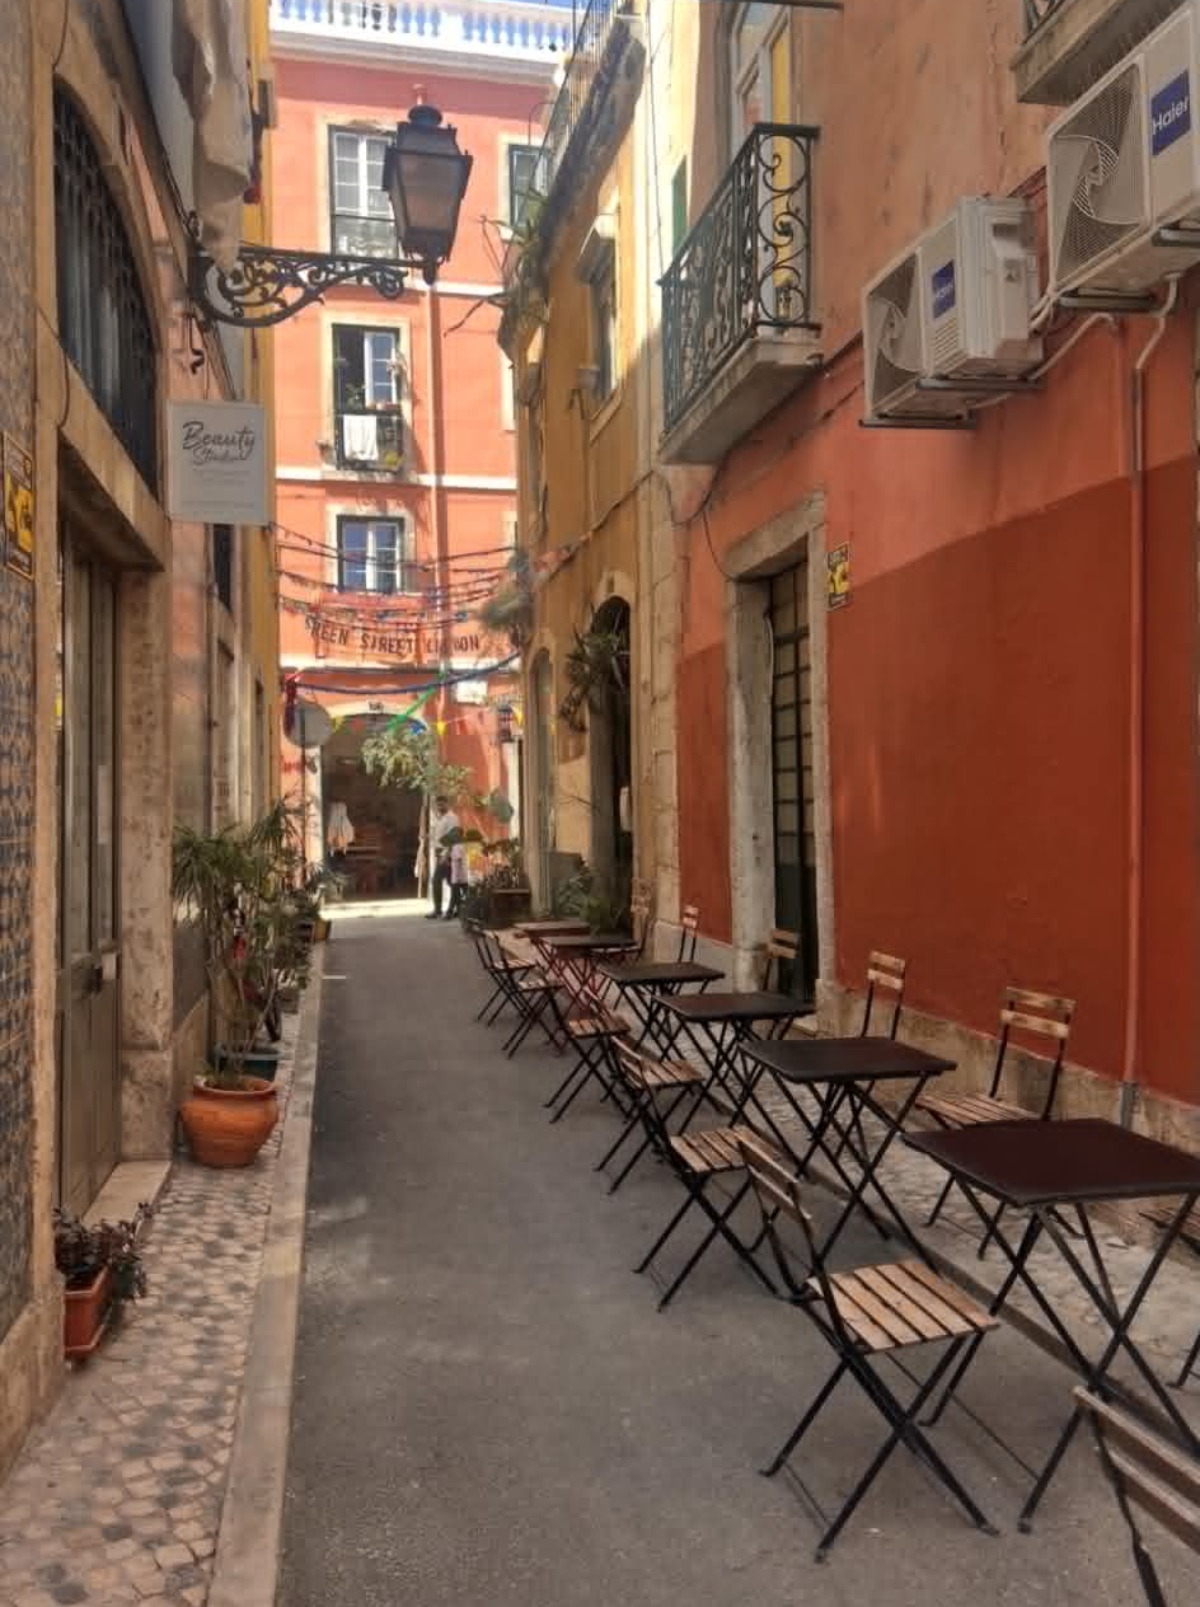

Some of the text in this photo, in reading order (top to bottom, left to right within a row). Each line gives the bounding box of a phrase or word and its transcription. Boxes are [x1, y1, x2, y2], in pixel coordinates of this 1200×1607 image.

[1152, 96, 1189, 136] Haier
[182, 420, 255, 461] Beauty
[360, 632, 414, 654] STREET
[426, 634, 479, 653] LION
